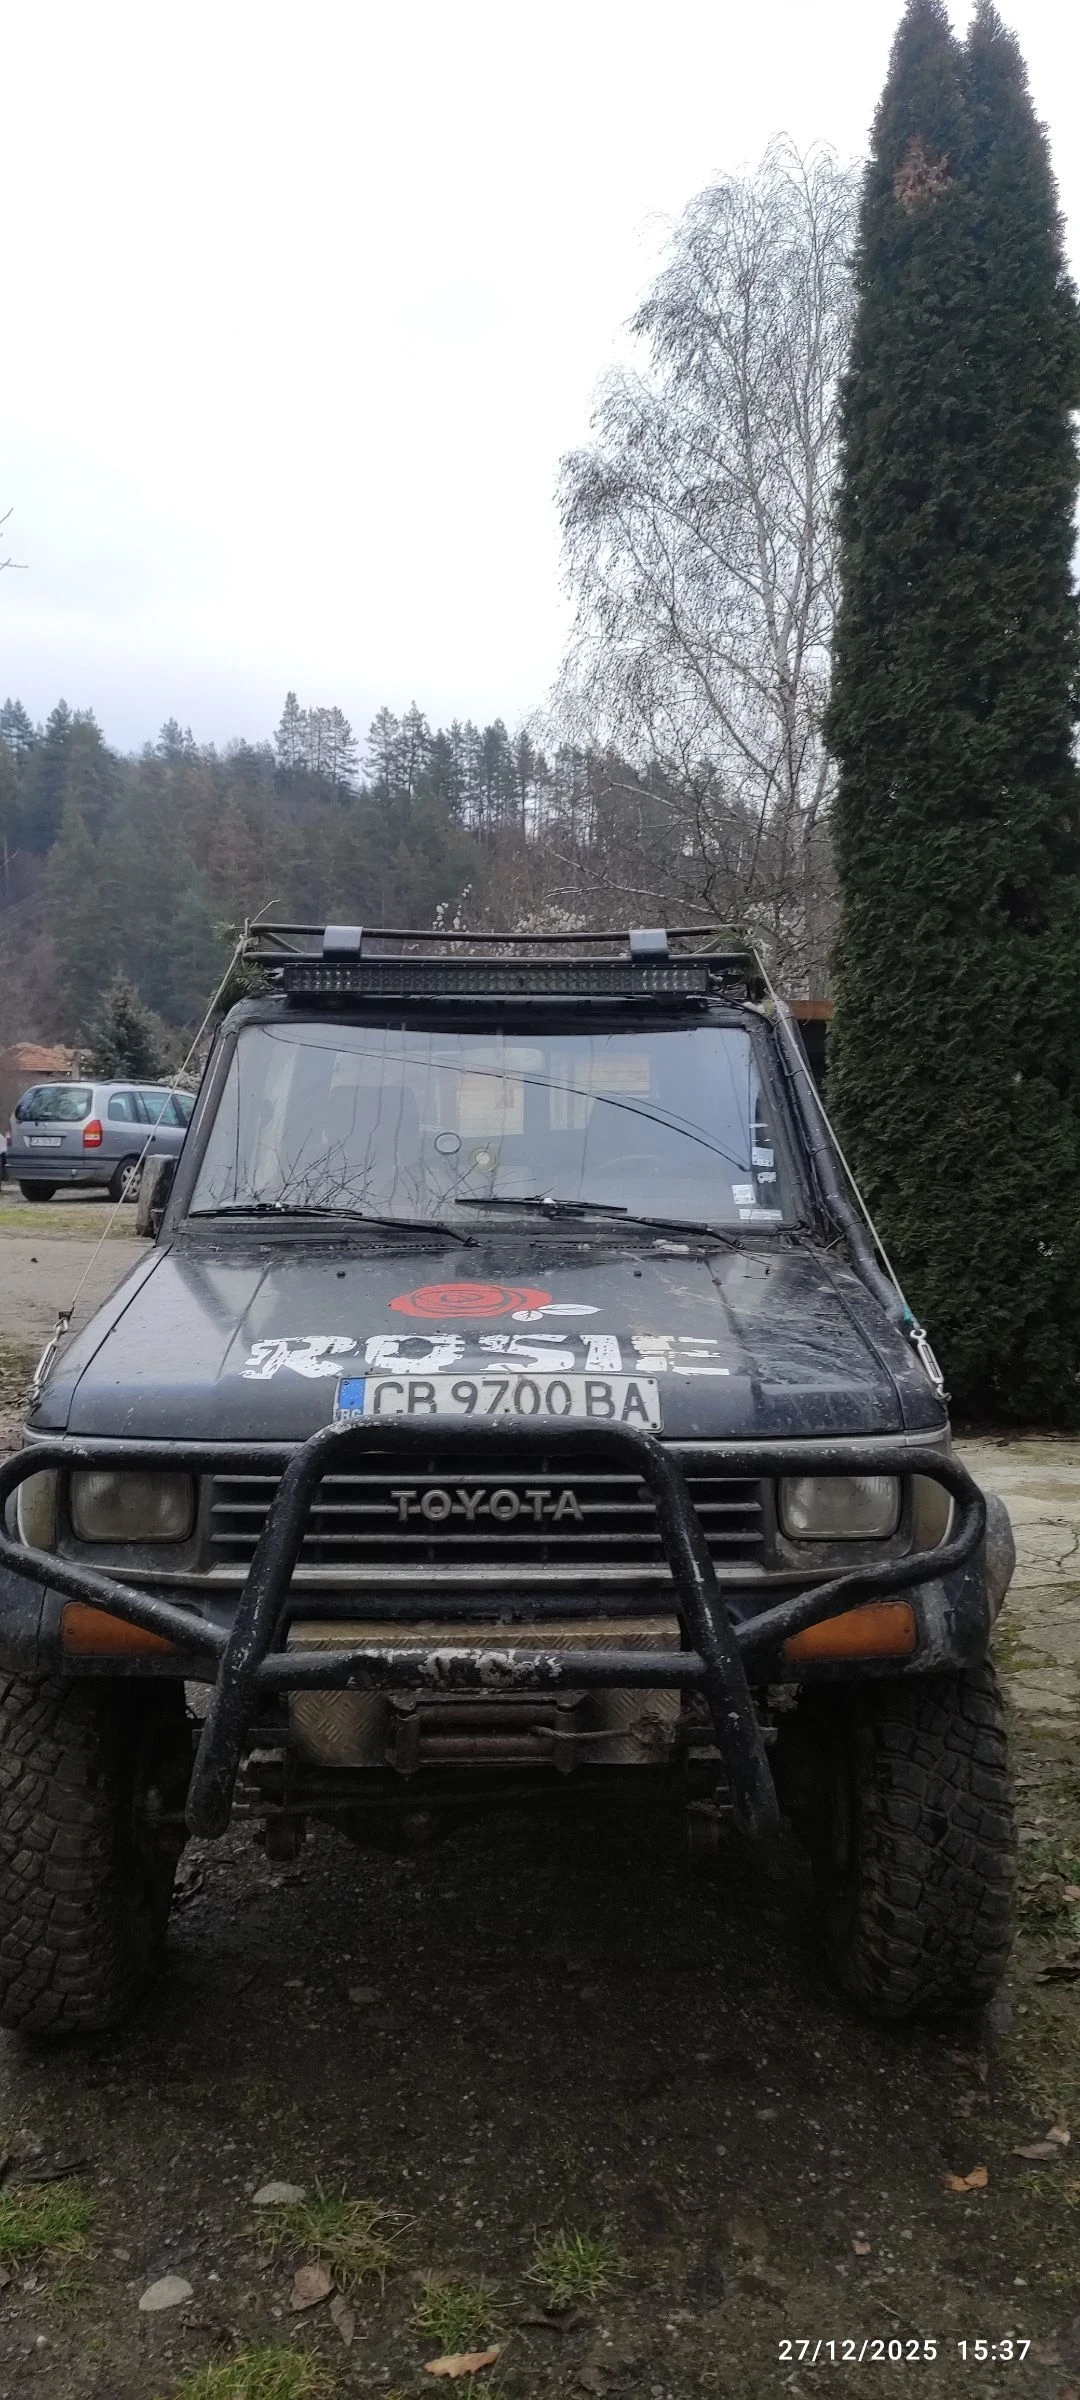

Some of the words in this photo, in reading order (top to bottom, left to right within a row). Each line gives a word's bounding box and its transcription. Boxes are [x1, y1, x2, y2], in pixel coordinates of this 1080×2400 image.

[239, 1334, 730, 1380] ROSIE
[374, 1382, 437, 1414] CB
[451, 1380, 572, 1414] 9700
[584, 1381, 650, 1422] BA
[390, 1489, 584, 1521] TOYOTA
